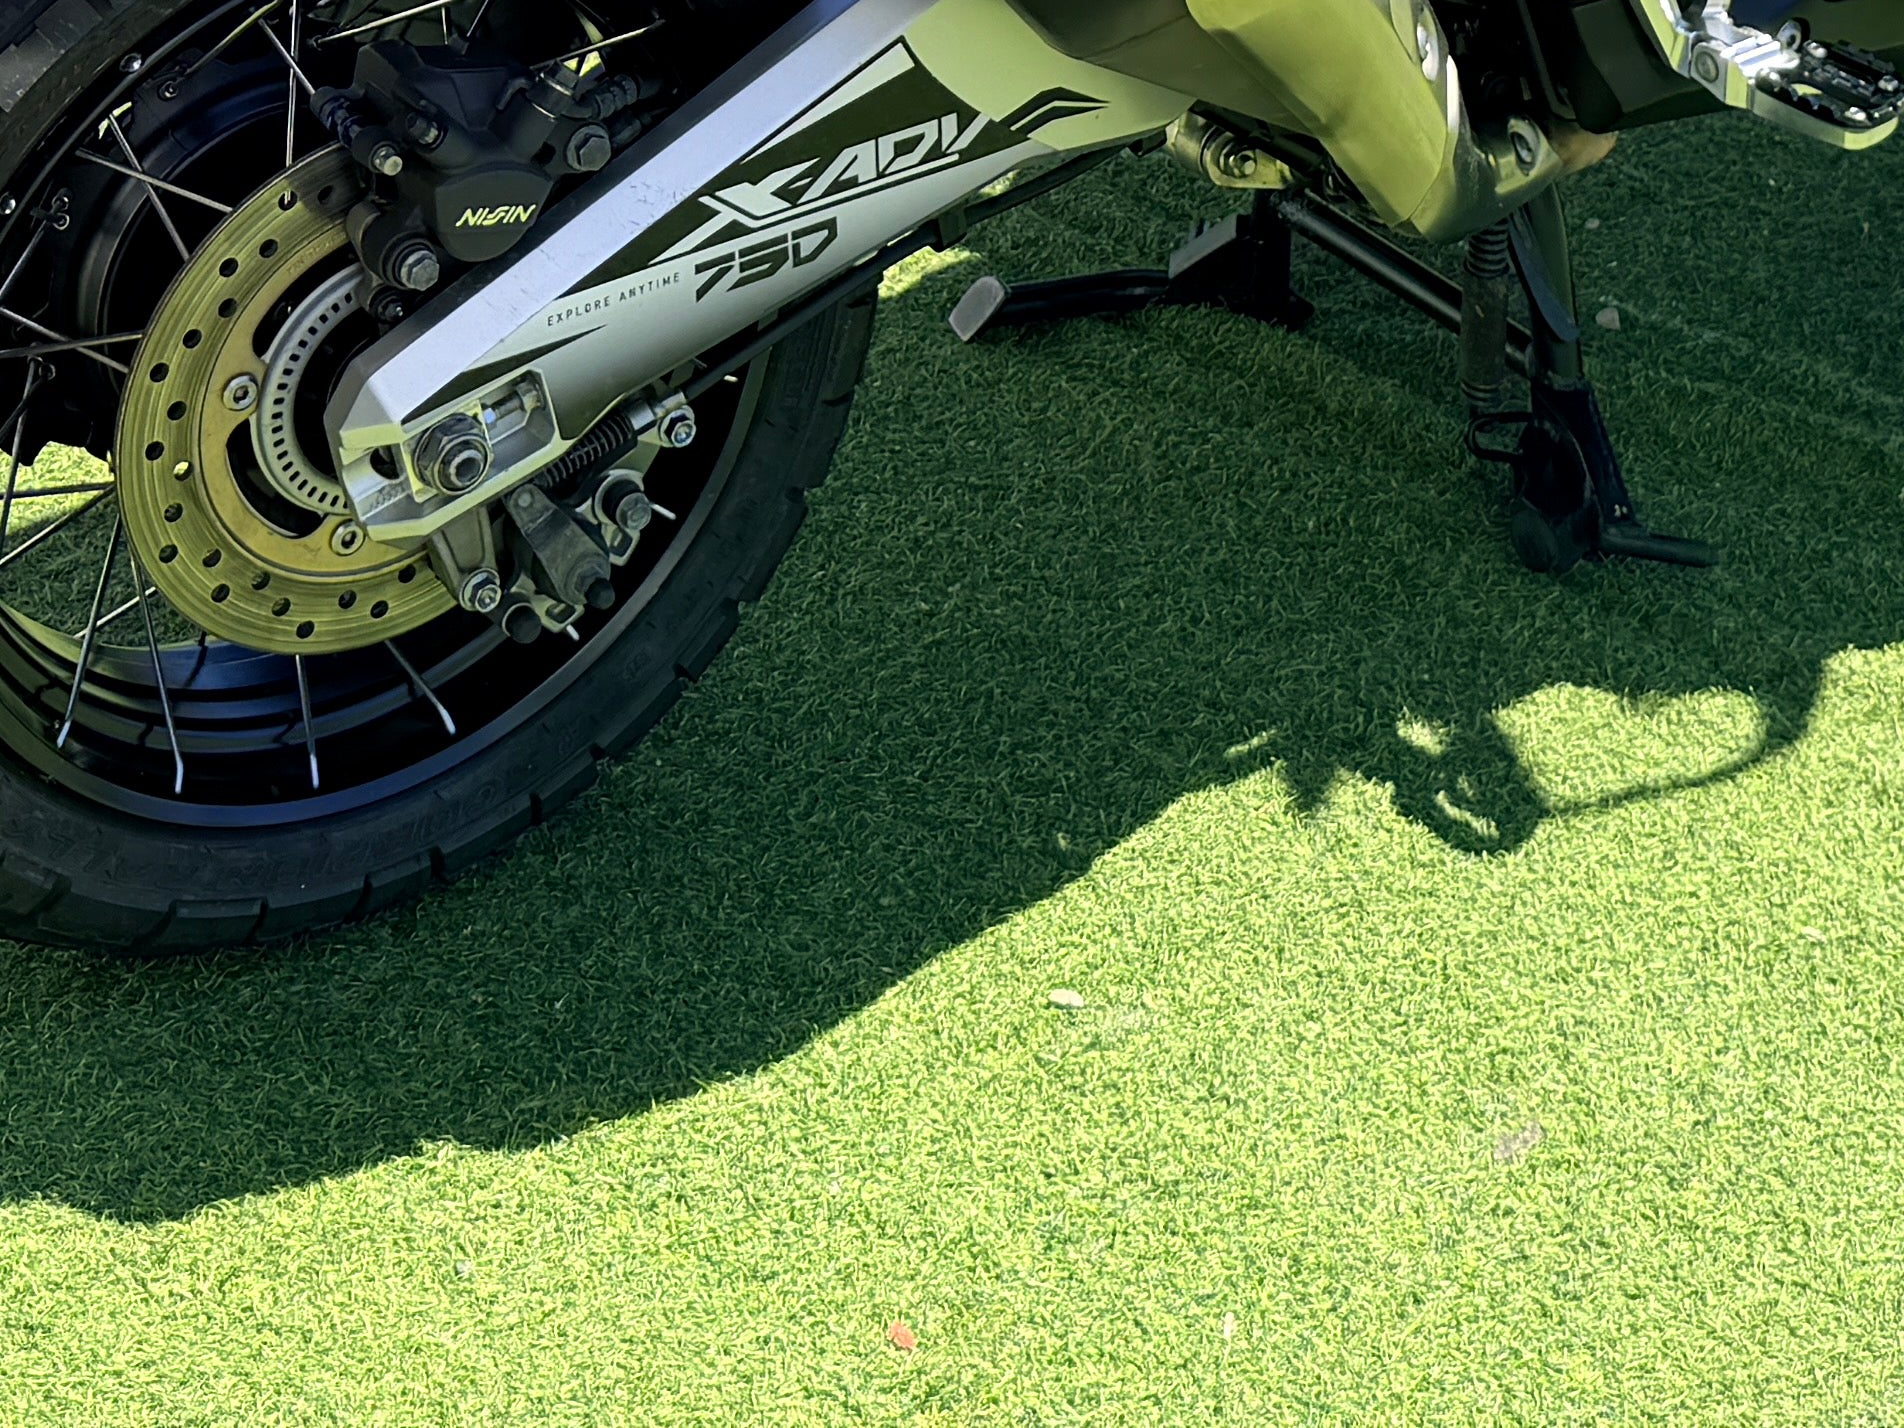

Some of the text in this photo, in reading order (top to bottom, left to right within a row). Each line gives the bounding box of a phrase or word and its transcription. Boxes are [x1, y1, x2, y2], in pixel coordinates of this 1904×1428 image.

[693, 216, 839, 304] 750
[546, 271, 682, 328] EXPLORE ANYTIME
